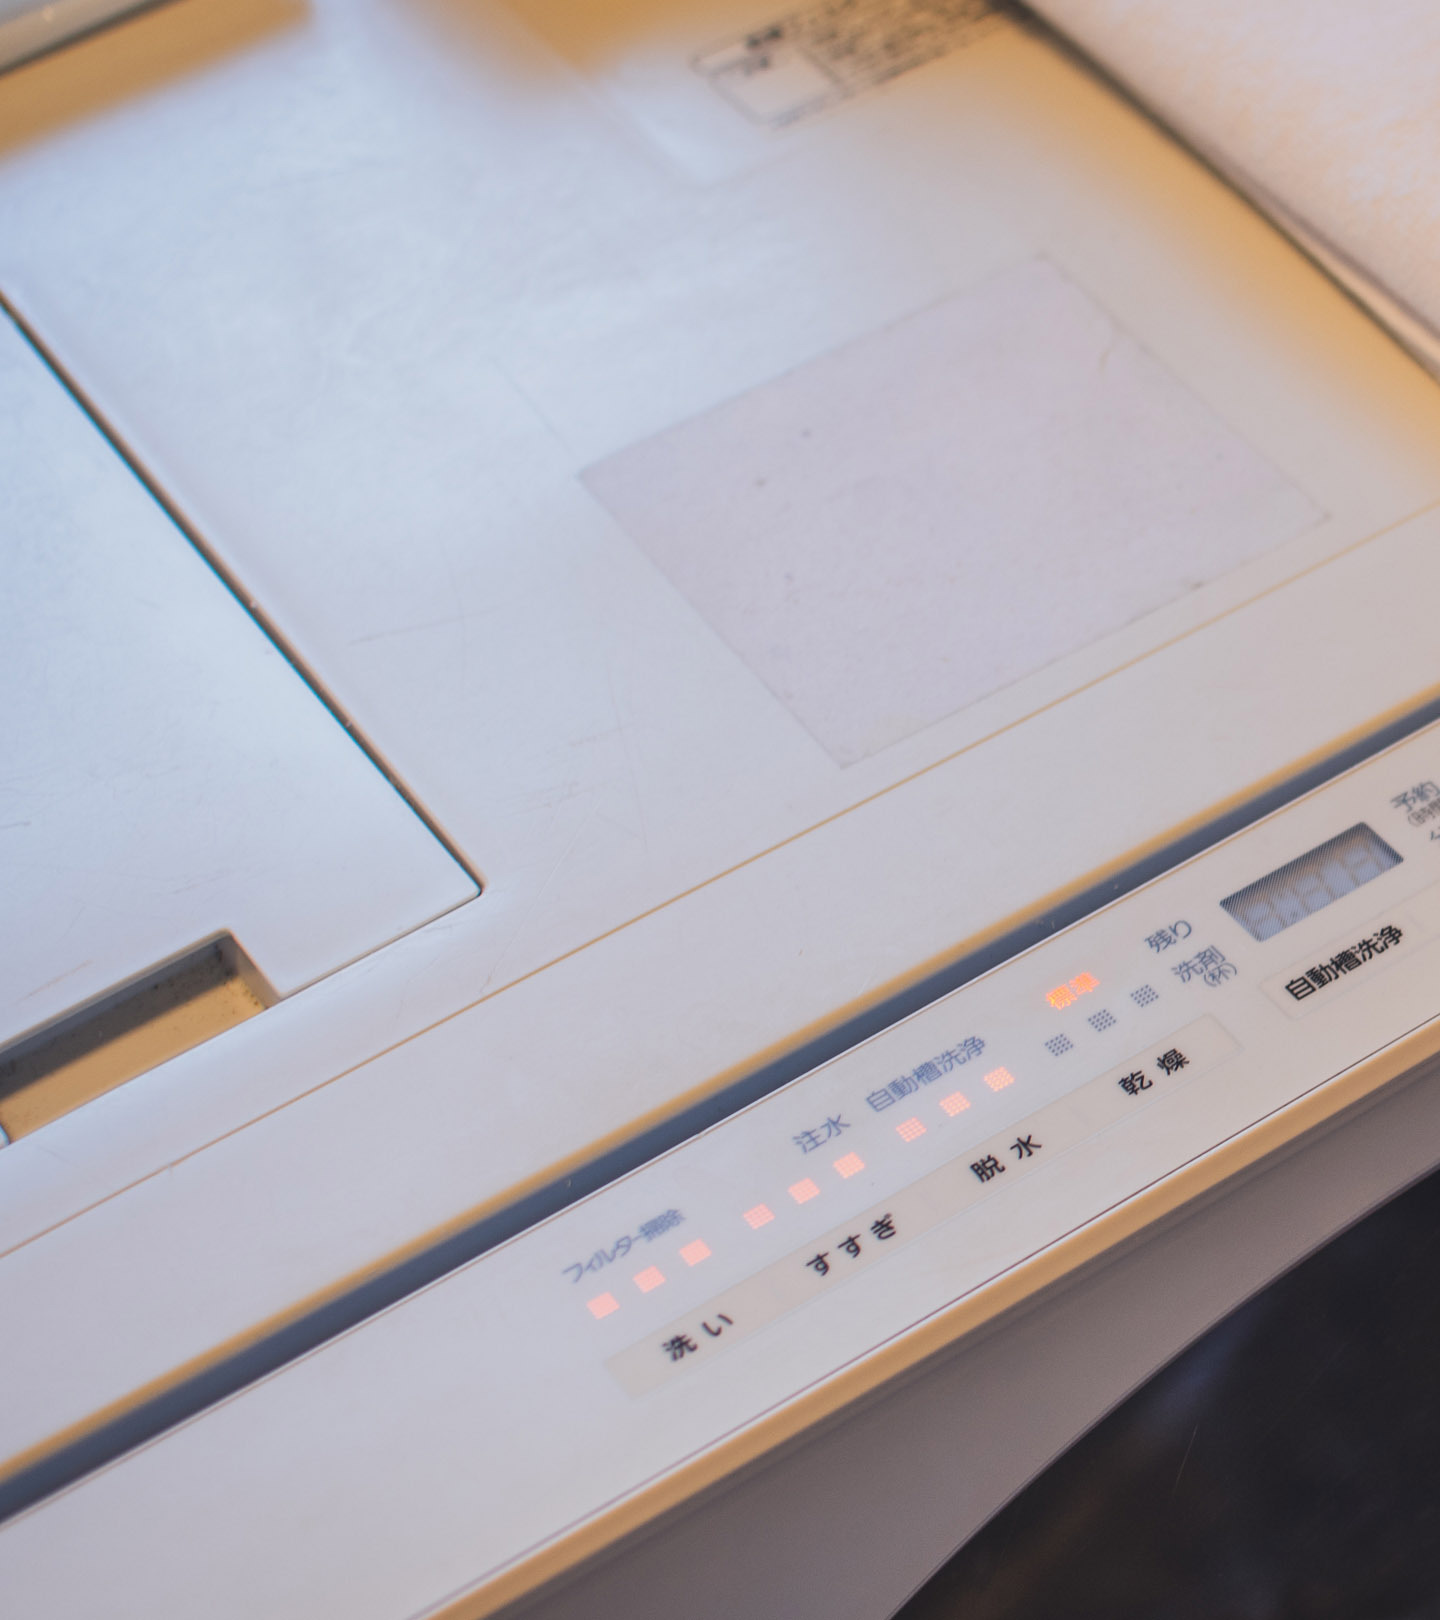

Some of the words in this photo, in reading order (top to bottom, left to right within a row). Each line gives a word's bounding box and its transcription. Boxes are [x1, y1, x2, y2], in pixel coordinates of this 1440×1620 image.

[1391, 780, 1440, 812] 予約
[1145, 919, 1192, 953] 残り
[1171, 945, 1226, 983] 洗剤
[1285, 924, 1403, 1001] 自動槽洗浄
[866, 1035, 986, 1112] 自動槽洗浄
[1118, 1048, 1190, 1098] 乾燥
[792, 1112, 851, 1154] 注水
[970, 1133, 1043, 1183] 脱水
[806, 1213, 897, 1276] すすぎ
[662, 1312, 734, 1362] 洗い
